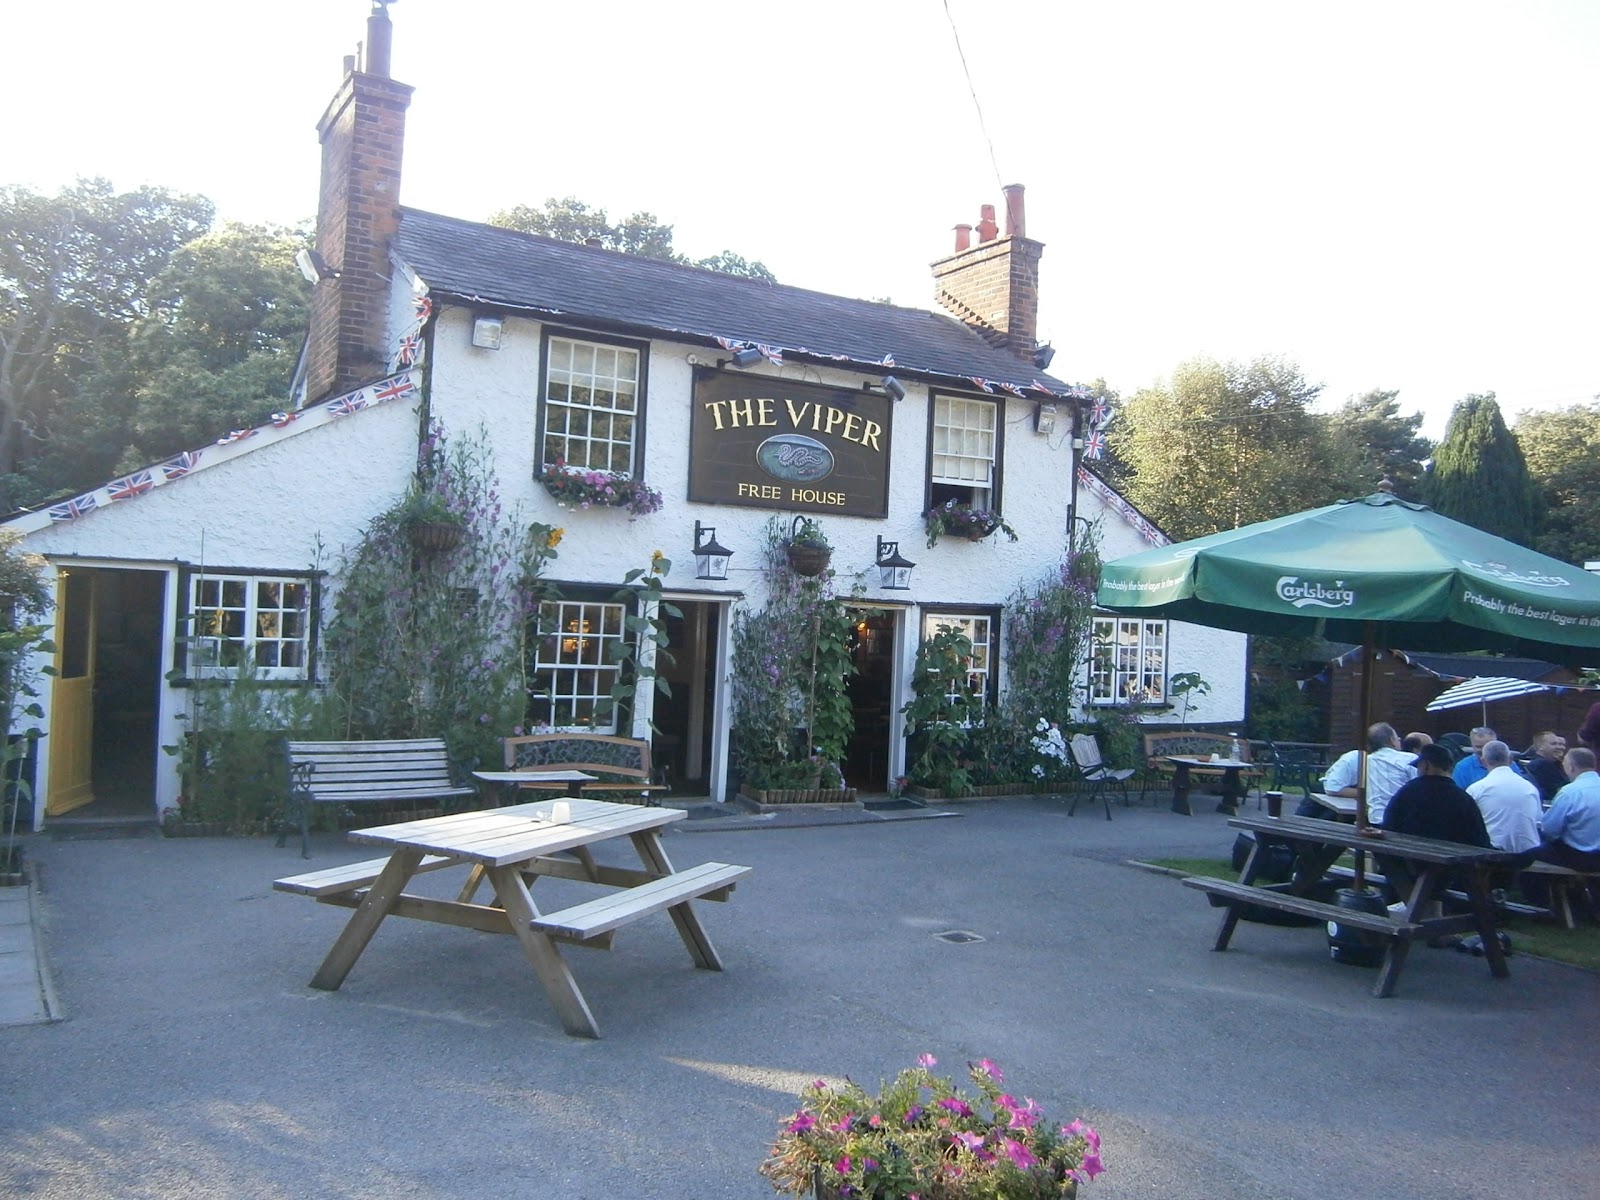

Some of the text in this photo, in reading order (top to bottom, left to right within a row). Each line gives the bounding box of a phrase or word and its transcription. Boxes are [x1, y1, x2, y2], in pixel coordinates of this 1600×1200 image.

[705, 399, 882, 452] THE VIPER
[738, 483, 846, 506] FREE HOUSE
[1276, 576, 1354, 607] Carlsberg
[1463, 591, 1506, 614] Probably
[1507, 603, 1525, 615] the
[1526, 606, 1549, 619] best
[1550, 610, 1578, 625] lager
[1578, 615, 1589, 626] in
